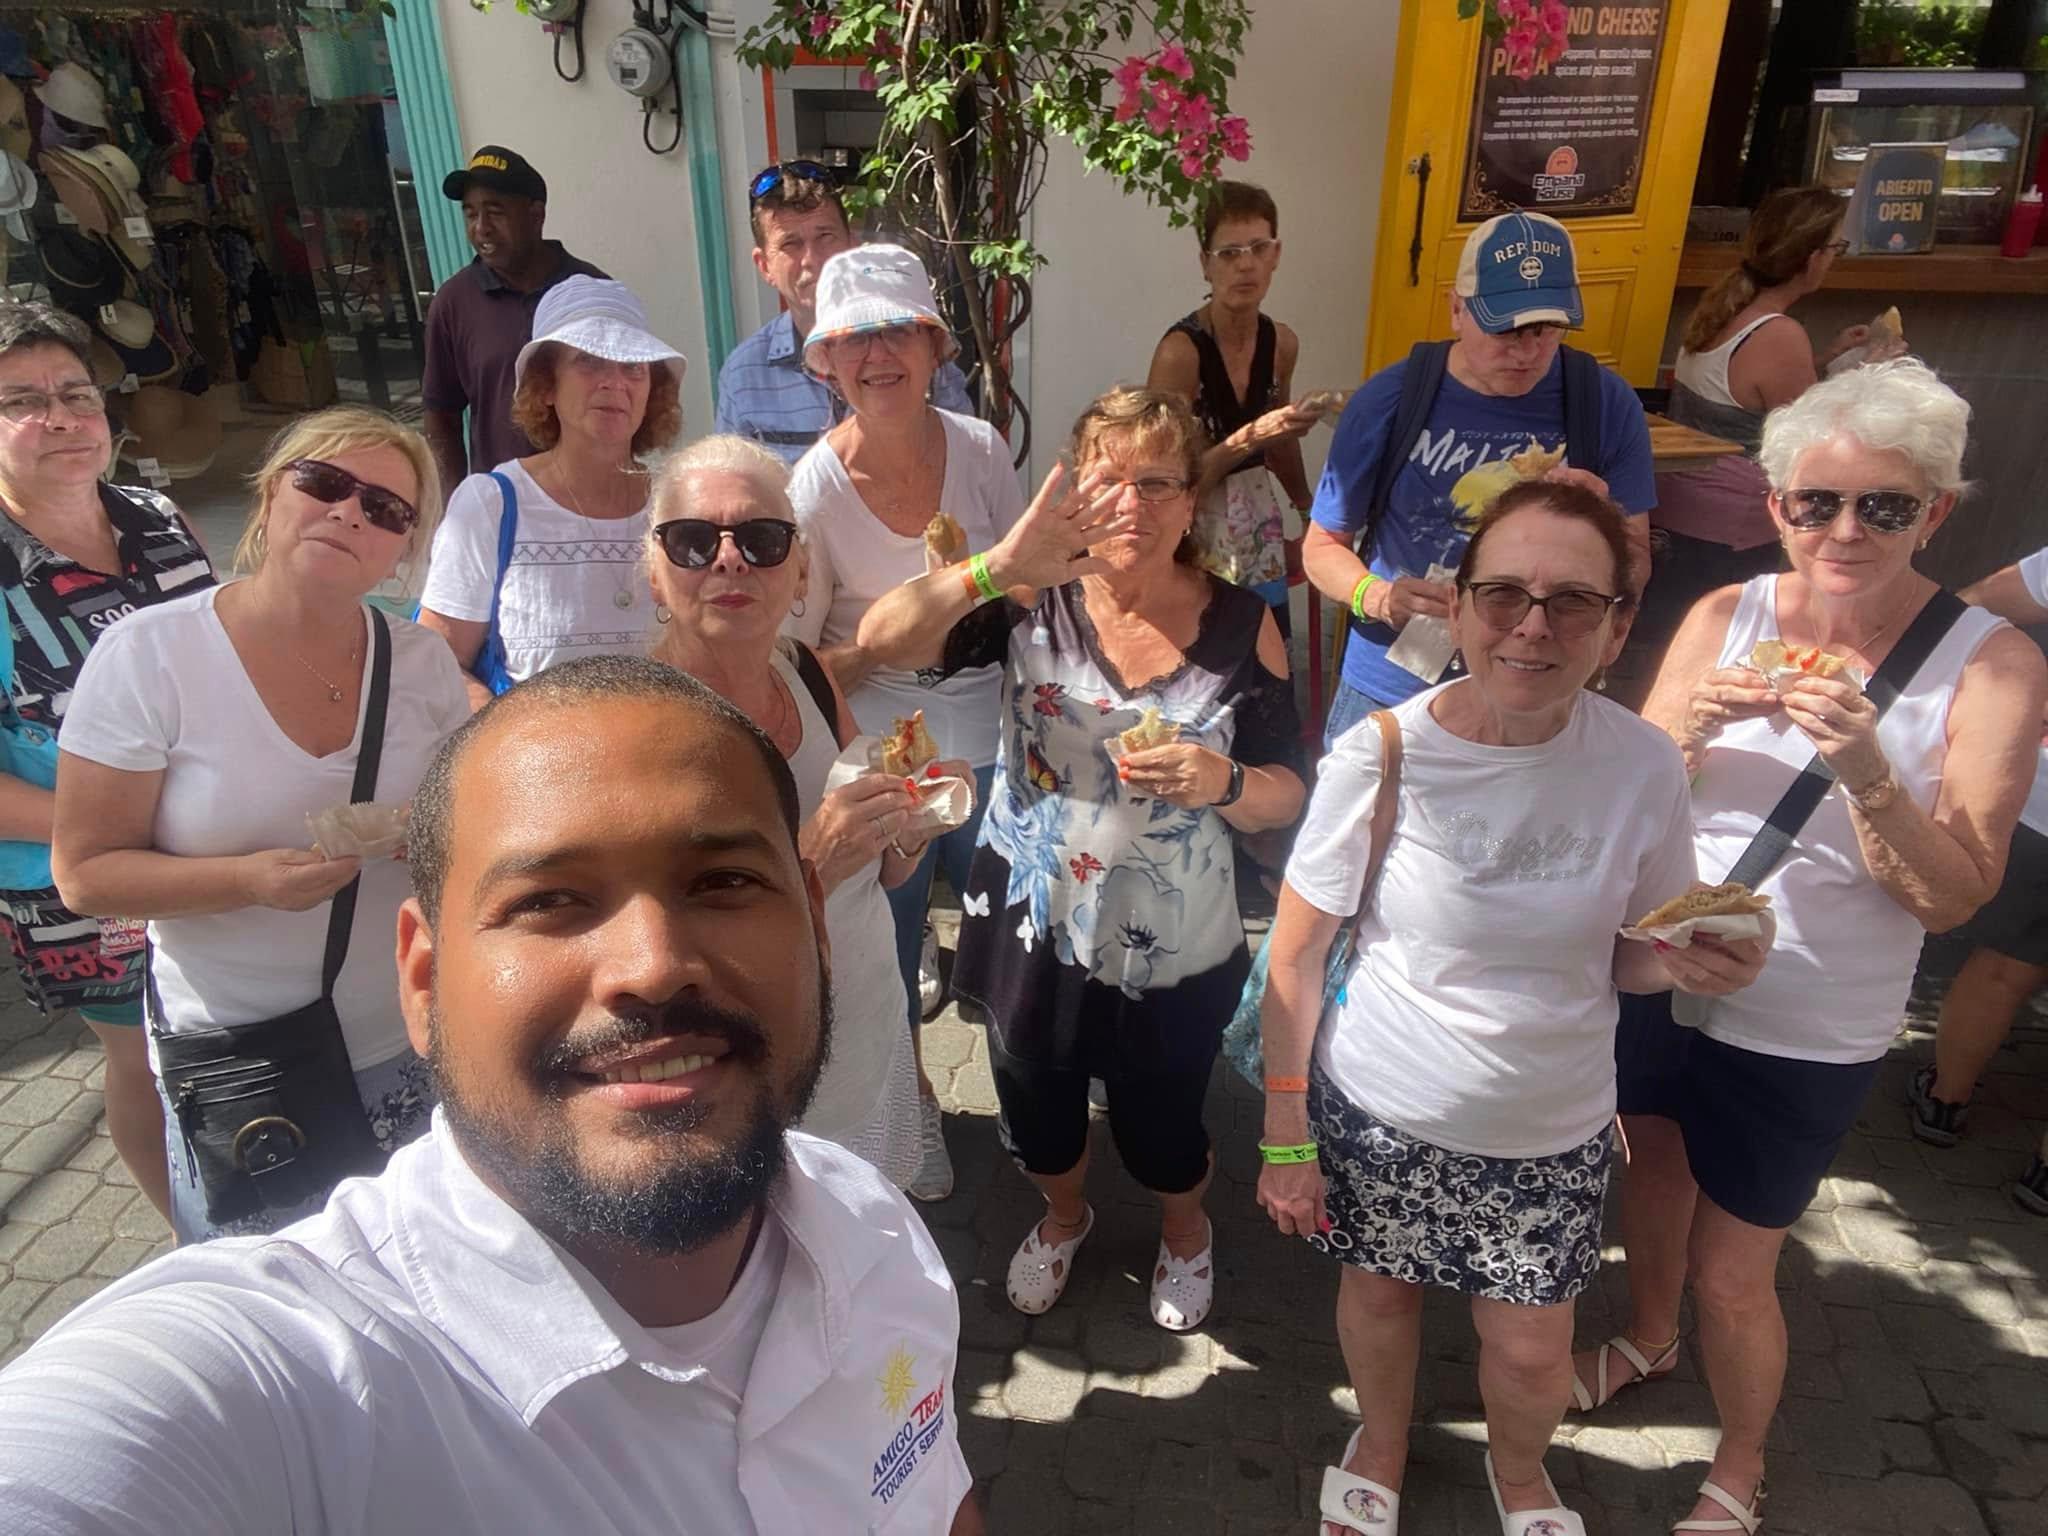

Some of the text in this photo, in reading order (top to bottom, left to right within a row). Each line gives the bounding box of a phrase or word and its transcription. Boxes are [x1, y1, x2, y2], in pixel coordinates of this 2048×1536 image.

[1566, 7, 1593, 35] ND
[1597, 7, 1661, 36] CHEESE
[1875, 179, 1934, 197] ABIERTO
[1879, 202, 1924, 222] OPEN
[1494, 240, 1561, 264] REP DOM
[872, 1422, 914, 1483] AMIGO
[879, 1450, 919, 1505] TOURIST
